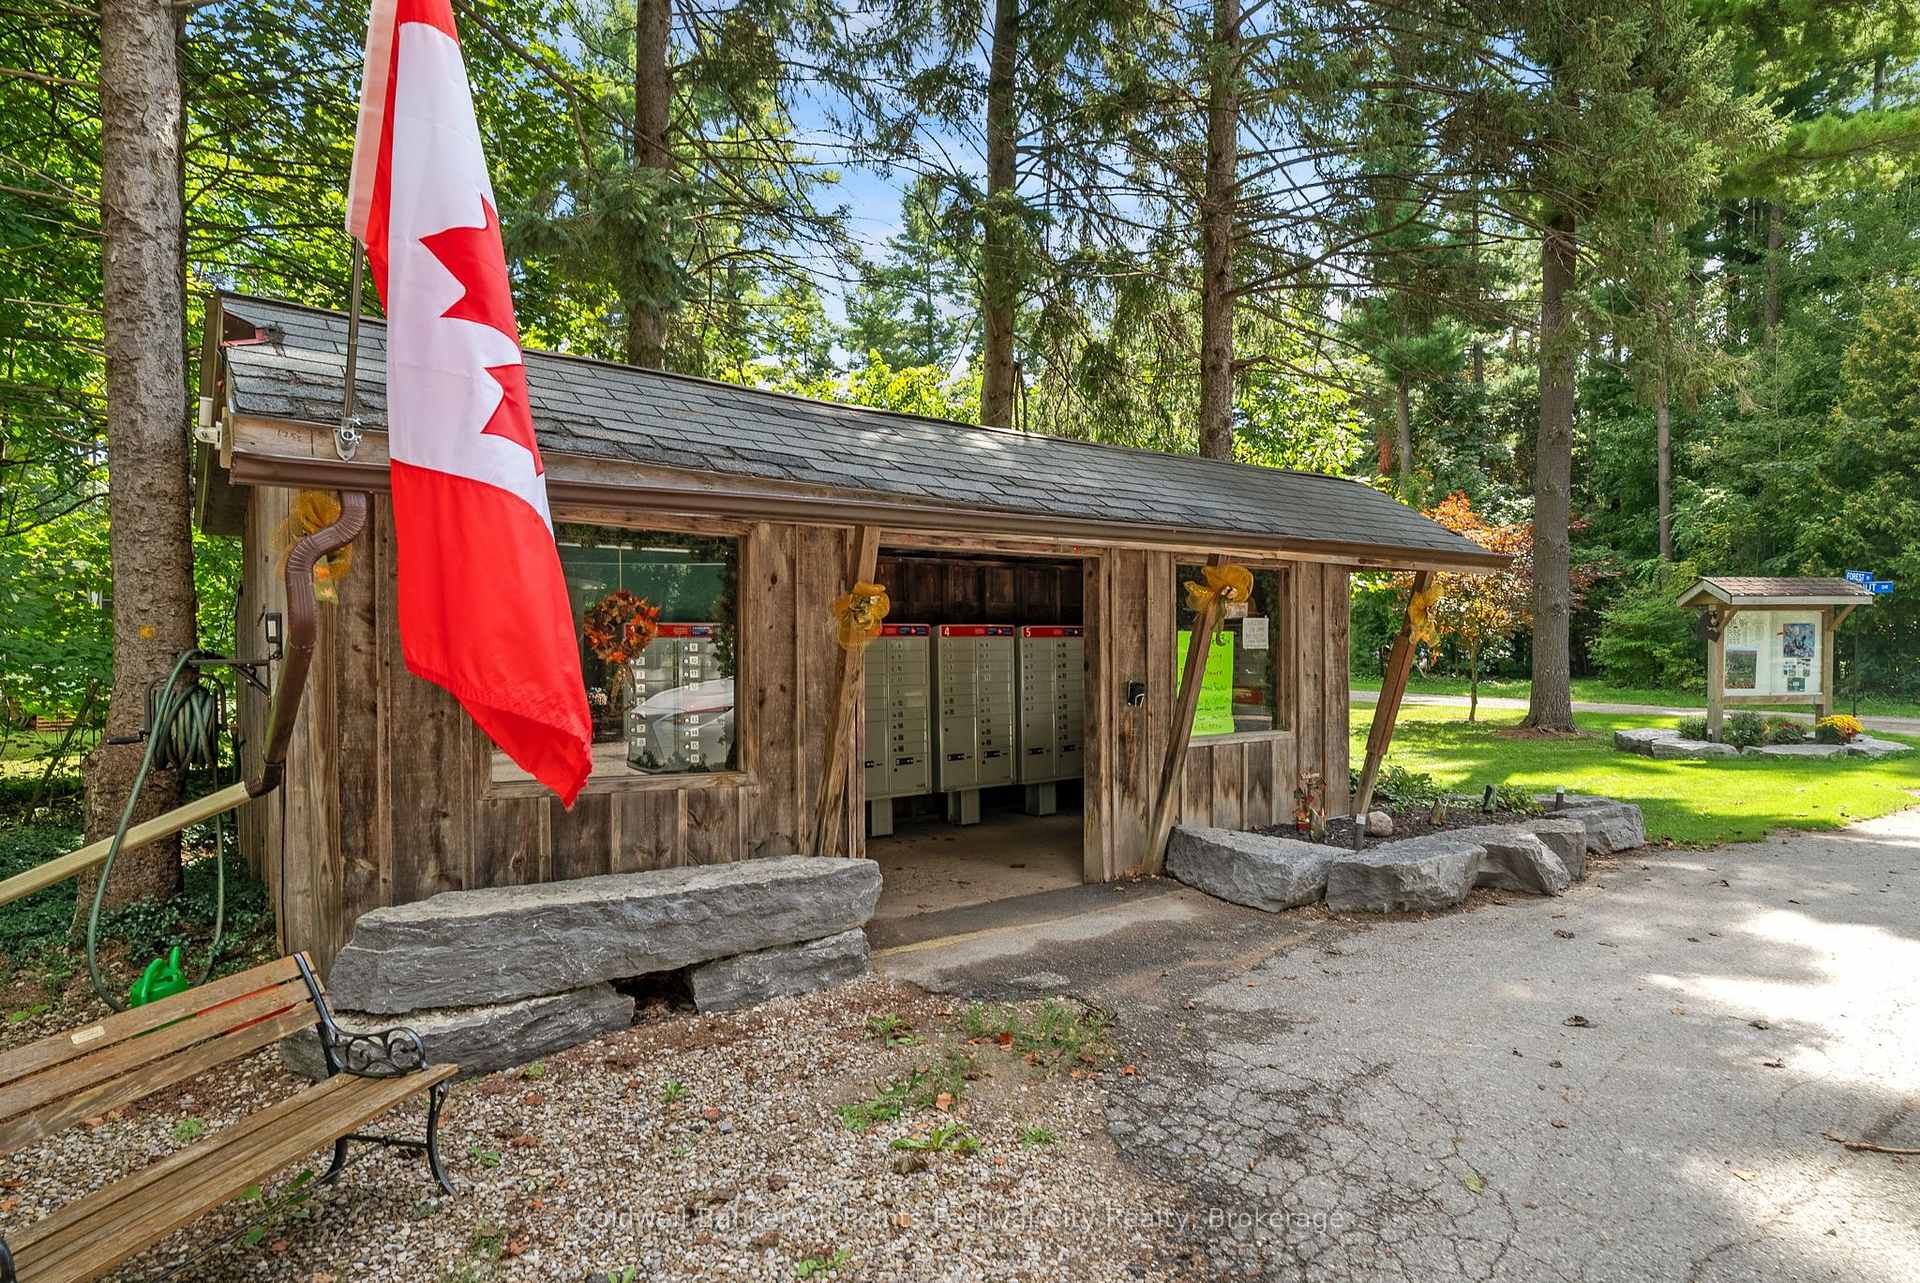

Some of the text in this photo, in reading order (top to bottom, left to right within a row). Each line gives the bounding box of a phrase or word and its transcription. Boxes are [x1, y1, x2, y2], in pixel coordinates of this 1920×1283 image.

[1846, 572, 1865, 583] FOREST
[944, 626, 950, 636] 4
[1025, 628, 1031, 637] 5
